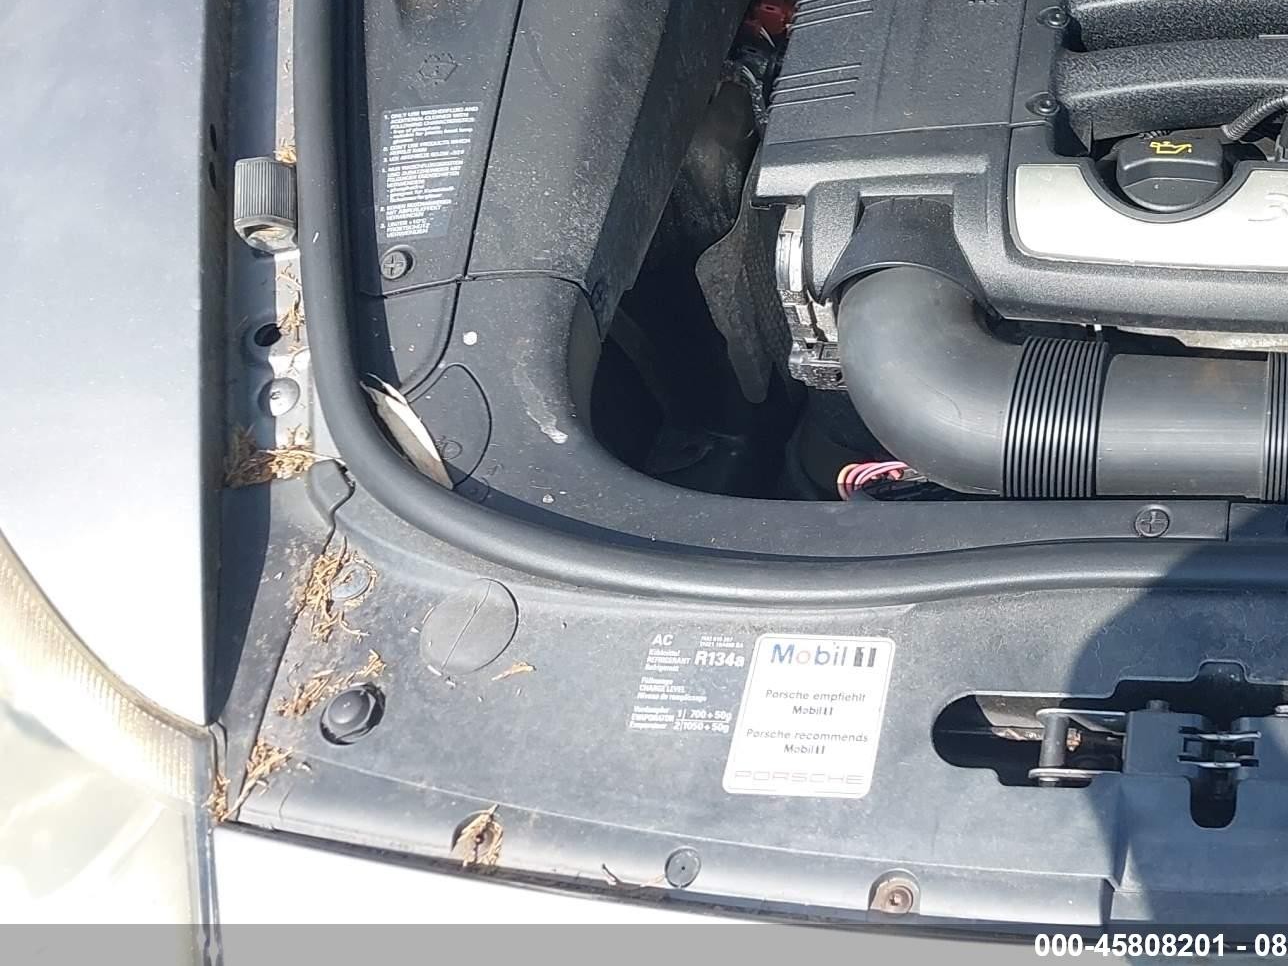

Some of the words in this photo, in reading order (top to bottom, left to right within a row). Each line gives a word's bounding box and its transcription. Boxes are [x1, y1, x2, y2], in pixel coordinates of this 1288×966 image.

[652, 634, 673, 646] AC
[695, 651, 745, 667] R134a
[770, 643, 848, 666] Mobil
[765, 689, 809, 701] Porsche
[813, 691, 866, 702] empfiehlt
[690, 709, 706, 718] 700
[714, 710, 732, 721] 50g
[792, 705, 822, 716] Mobil
[711, 723, 730, 733] 50g
[746, 728, 791, 739] Porsche
[794, 731, 868, 742] recommends
[783, 744, 813, 754] Mobil
[735, 771, 864, 785] PORSCHE
